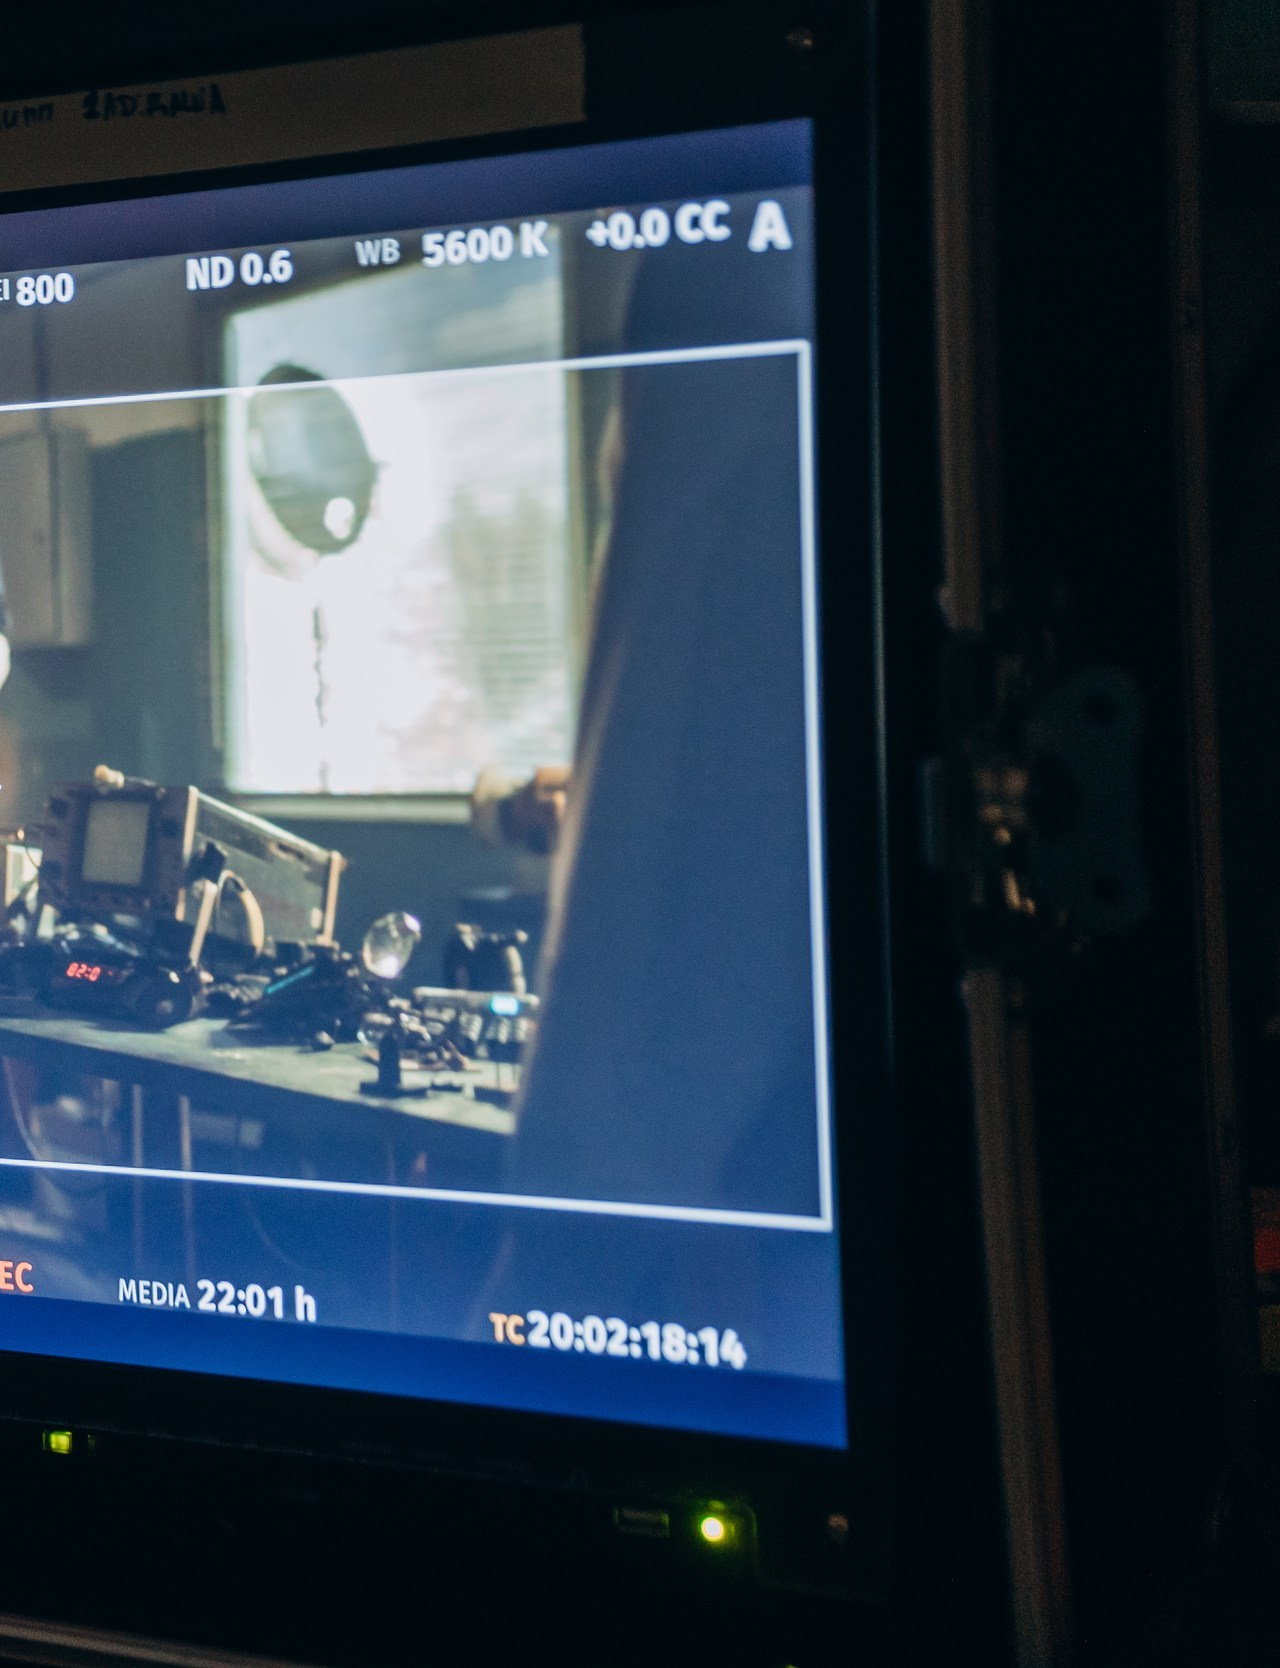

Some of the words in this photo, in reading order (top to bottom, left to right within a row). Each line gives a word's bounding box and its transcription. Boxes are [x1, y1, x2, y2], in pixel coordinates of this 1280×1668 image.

[355, 238, 400, 267] WB
[422, 226, 514, 268] 5600
[519, 220, 550, 258] K
[585, 207, 670, 250] +0.0
[674, 200, 731, 244] CC
[747, 200, 793, 253] A
[15, 273, 75, 306] 800
[186, 256, 235, 290] ND
[240, 250, 294, 285] 0.6
[119, 1278, 190, 1309] MEDIA
[197, 1279, 284, 1320] 22:01
[294, 1285, 317, 1323] h
[488, 1312, 526, 1346] TC
[526, 1309, 748, 1371] 20:02:18:14
